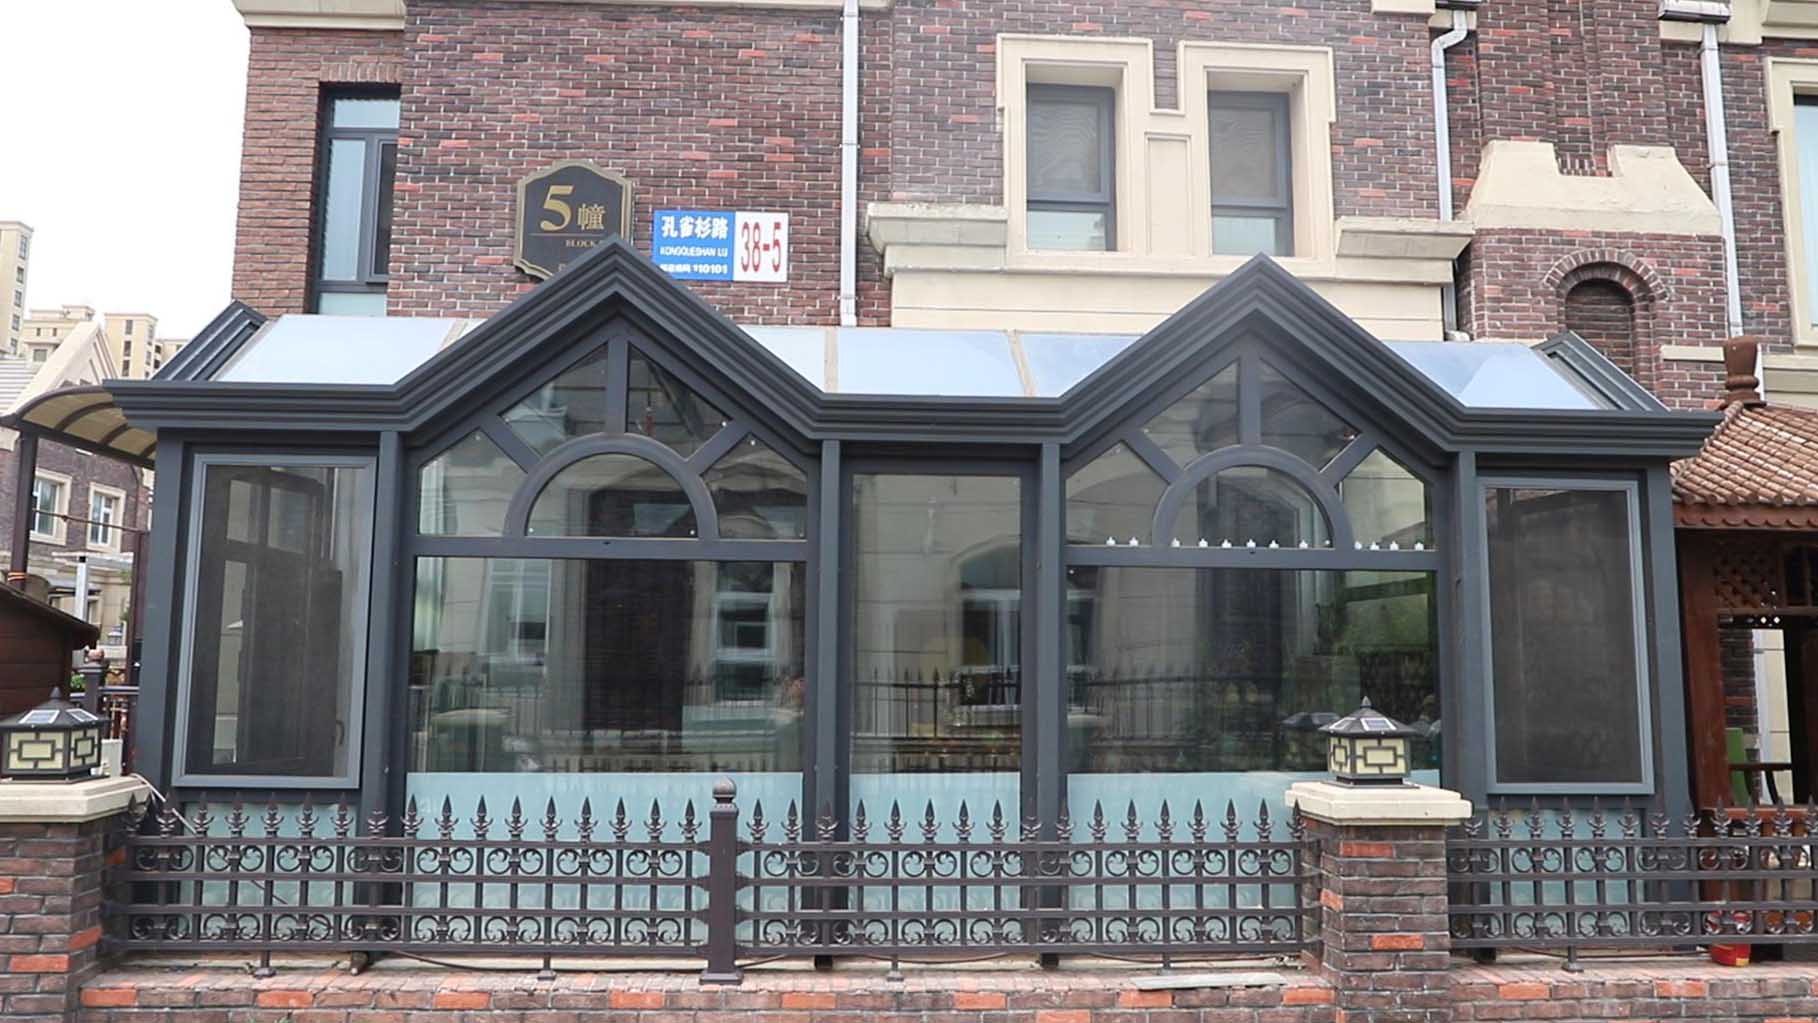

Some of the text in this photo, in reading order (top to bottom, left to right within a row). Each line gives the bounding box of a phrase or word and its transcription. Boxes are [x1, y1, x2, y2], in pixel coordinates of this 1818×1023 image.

[661, 215, 729, 239] 孔雀杉路
[717, 247, 729, 257] LU
[741, 221, 782, 273] 38-5
